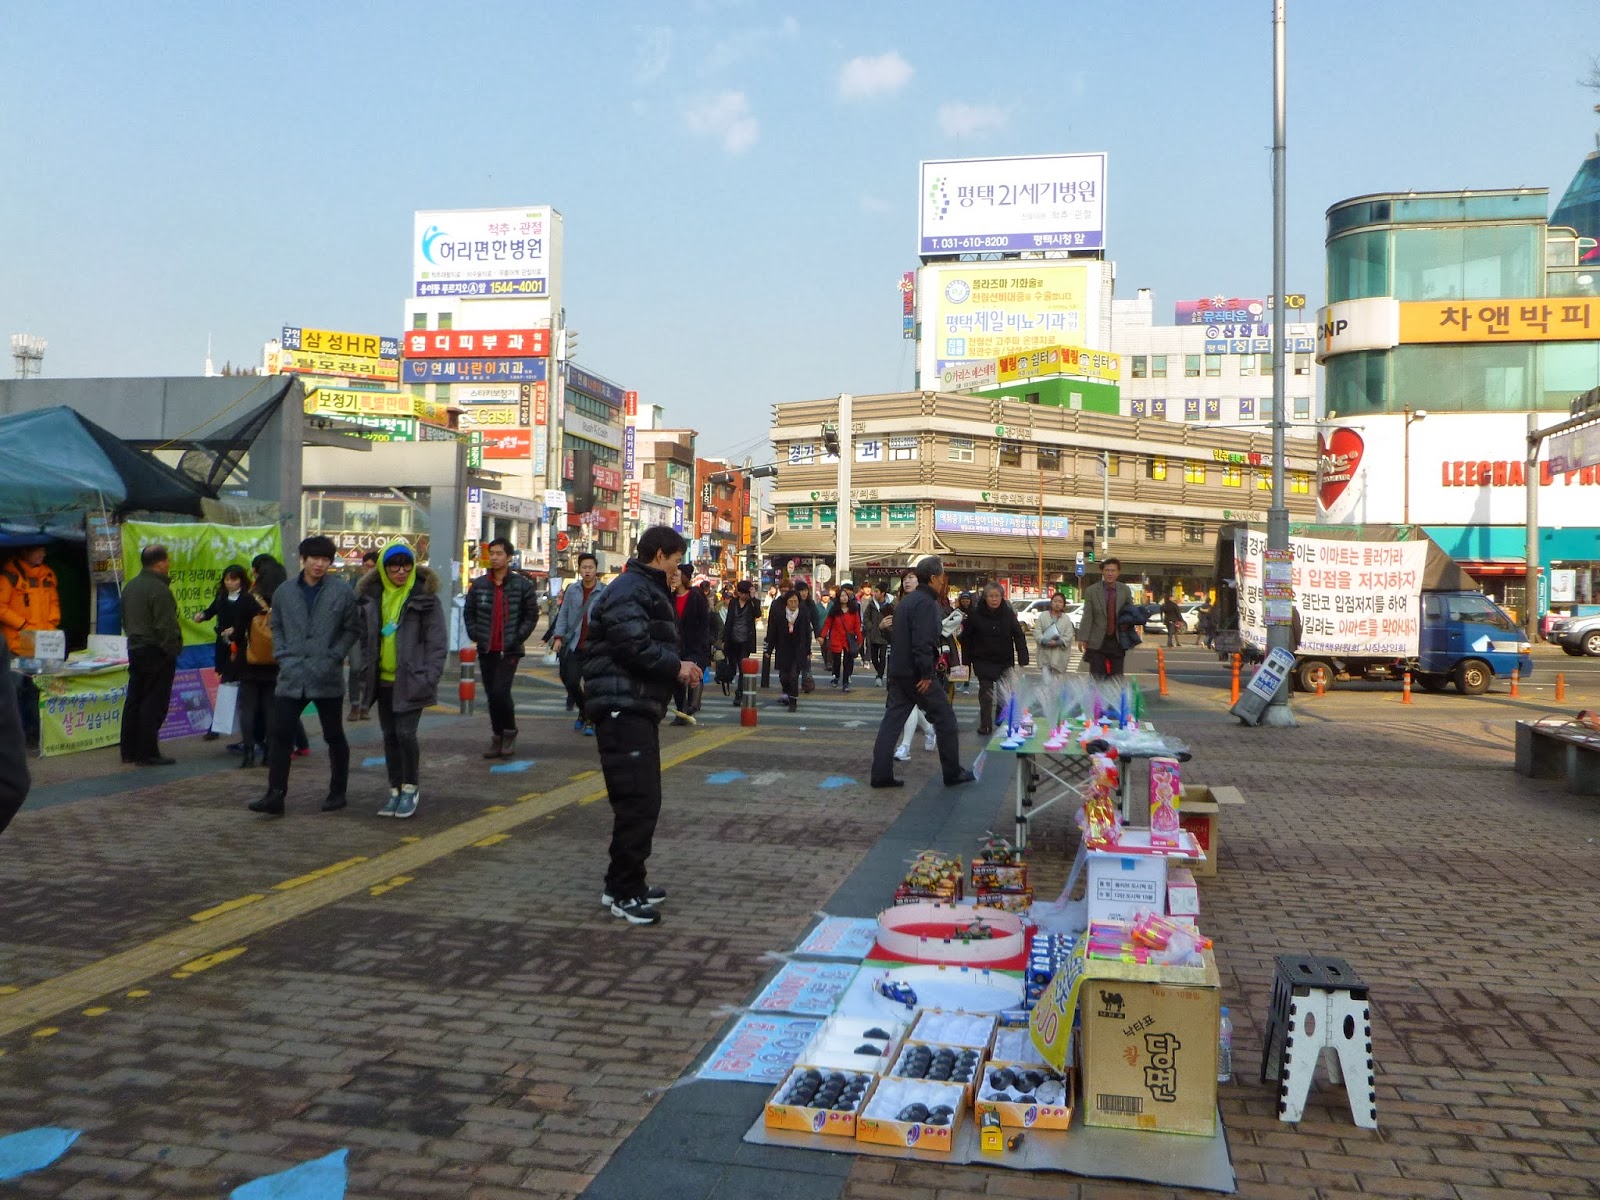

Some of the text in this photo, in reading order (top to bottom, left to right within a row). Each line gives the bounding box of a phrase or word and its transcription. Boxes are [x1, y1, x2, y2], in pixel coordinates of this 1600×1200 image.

[440, 238, 542, 262] 허리편한병원
[941, 236, 1009, 249] 031-610-8200
[1033, 234, 1072, 246] 평택시청
[1075, 233, 1085, 245] 앞
[420, 283, 441, 295] 용이동
[490, 280, 543, 293] 1544-4001
[1007, 312, 1067, 332] 비뇨기과
[1202, 309, 1248, 324] 뮤직타운
[1223, 323, 1270, 338] 산와머
[1317, 318, 1348, 341] CNP
[411, 335, 524, 351] 엠디피부과
[1031, 350, 1049, 367] 쉼터
[476, 408, 516, 425] Cash
[1320, 546, 1359, 566] 이마트는
[1363, 547, 1404, 566] 물러가라
[1308, 569, 1353, 590] 입점을
[1358, 570, 1417, 590] 저지하자
[1301, 592, 1331, 612] 결단코
[1334, 594, 1386, 613] 입점저지를
[1387, 594, 1408, 613] 하여
[1338, 618, 1379, 637] 이마트를
[1381, 617, 1418, 637] 막아내자
[1123, 1014, 1156, 1038] 낙타표
[1143, 1032, 1182, 1102] 당면
